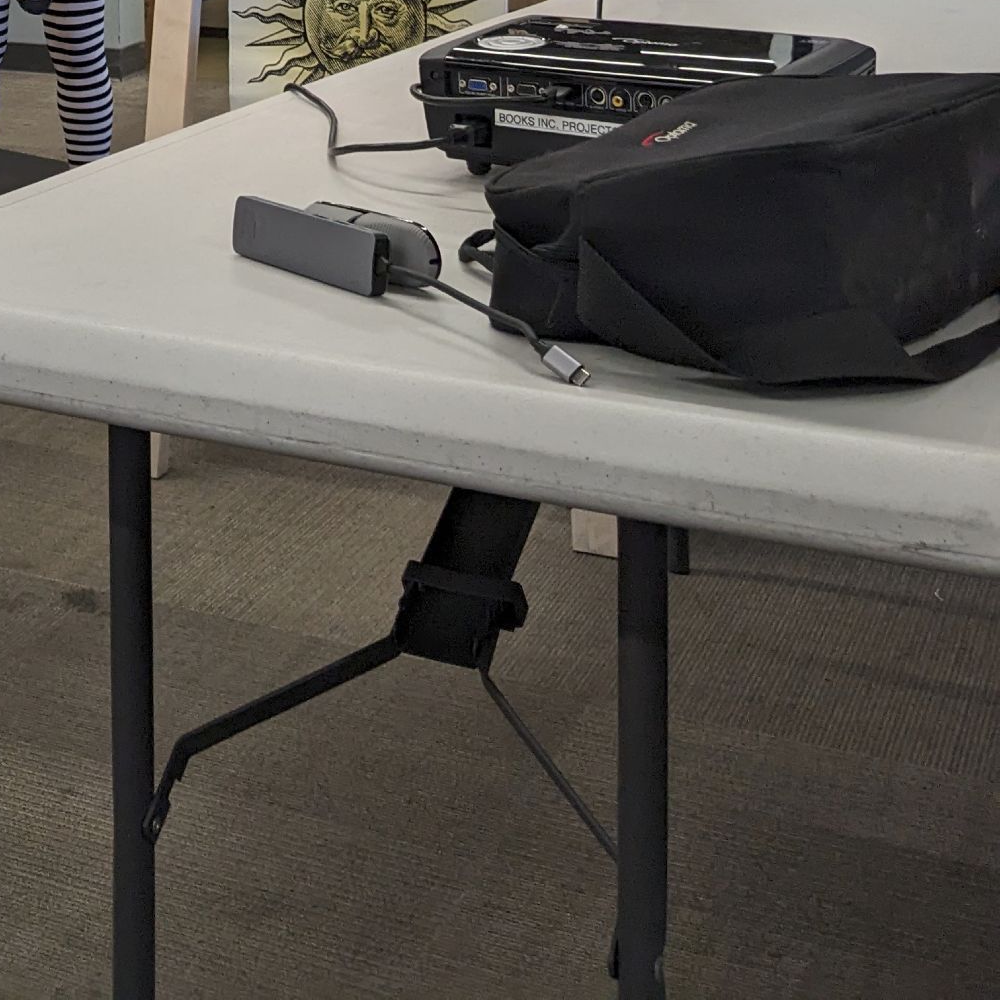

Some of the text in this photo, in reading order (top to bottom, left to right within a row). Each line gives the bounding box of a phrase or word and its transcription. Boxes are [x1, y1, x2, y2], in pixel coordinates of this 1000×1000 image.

[499, 113, 613, 136] BOOKS INC. PROJECT
[654, 121, 698, 144] Optoma
